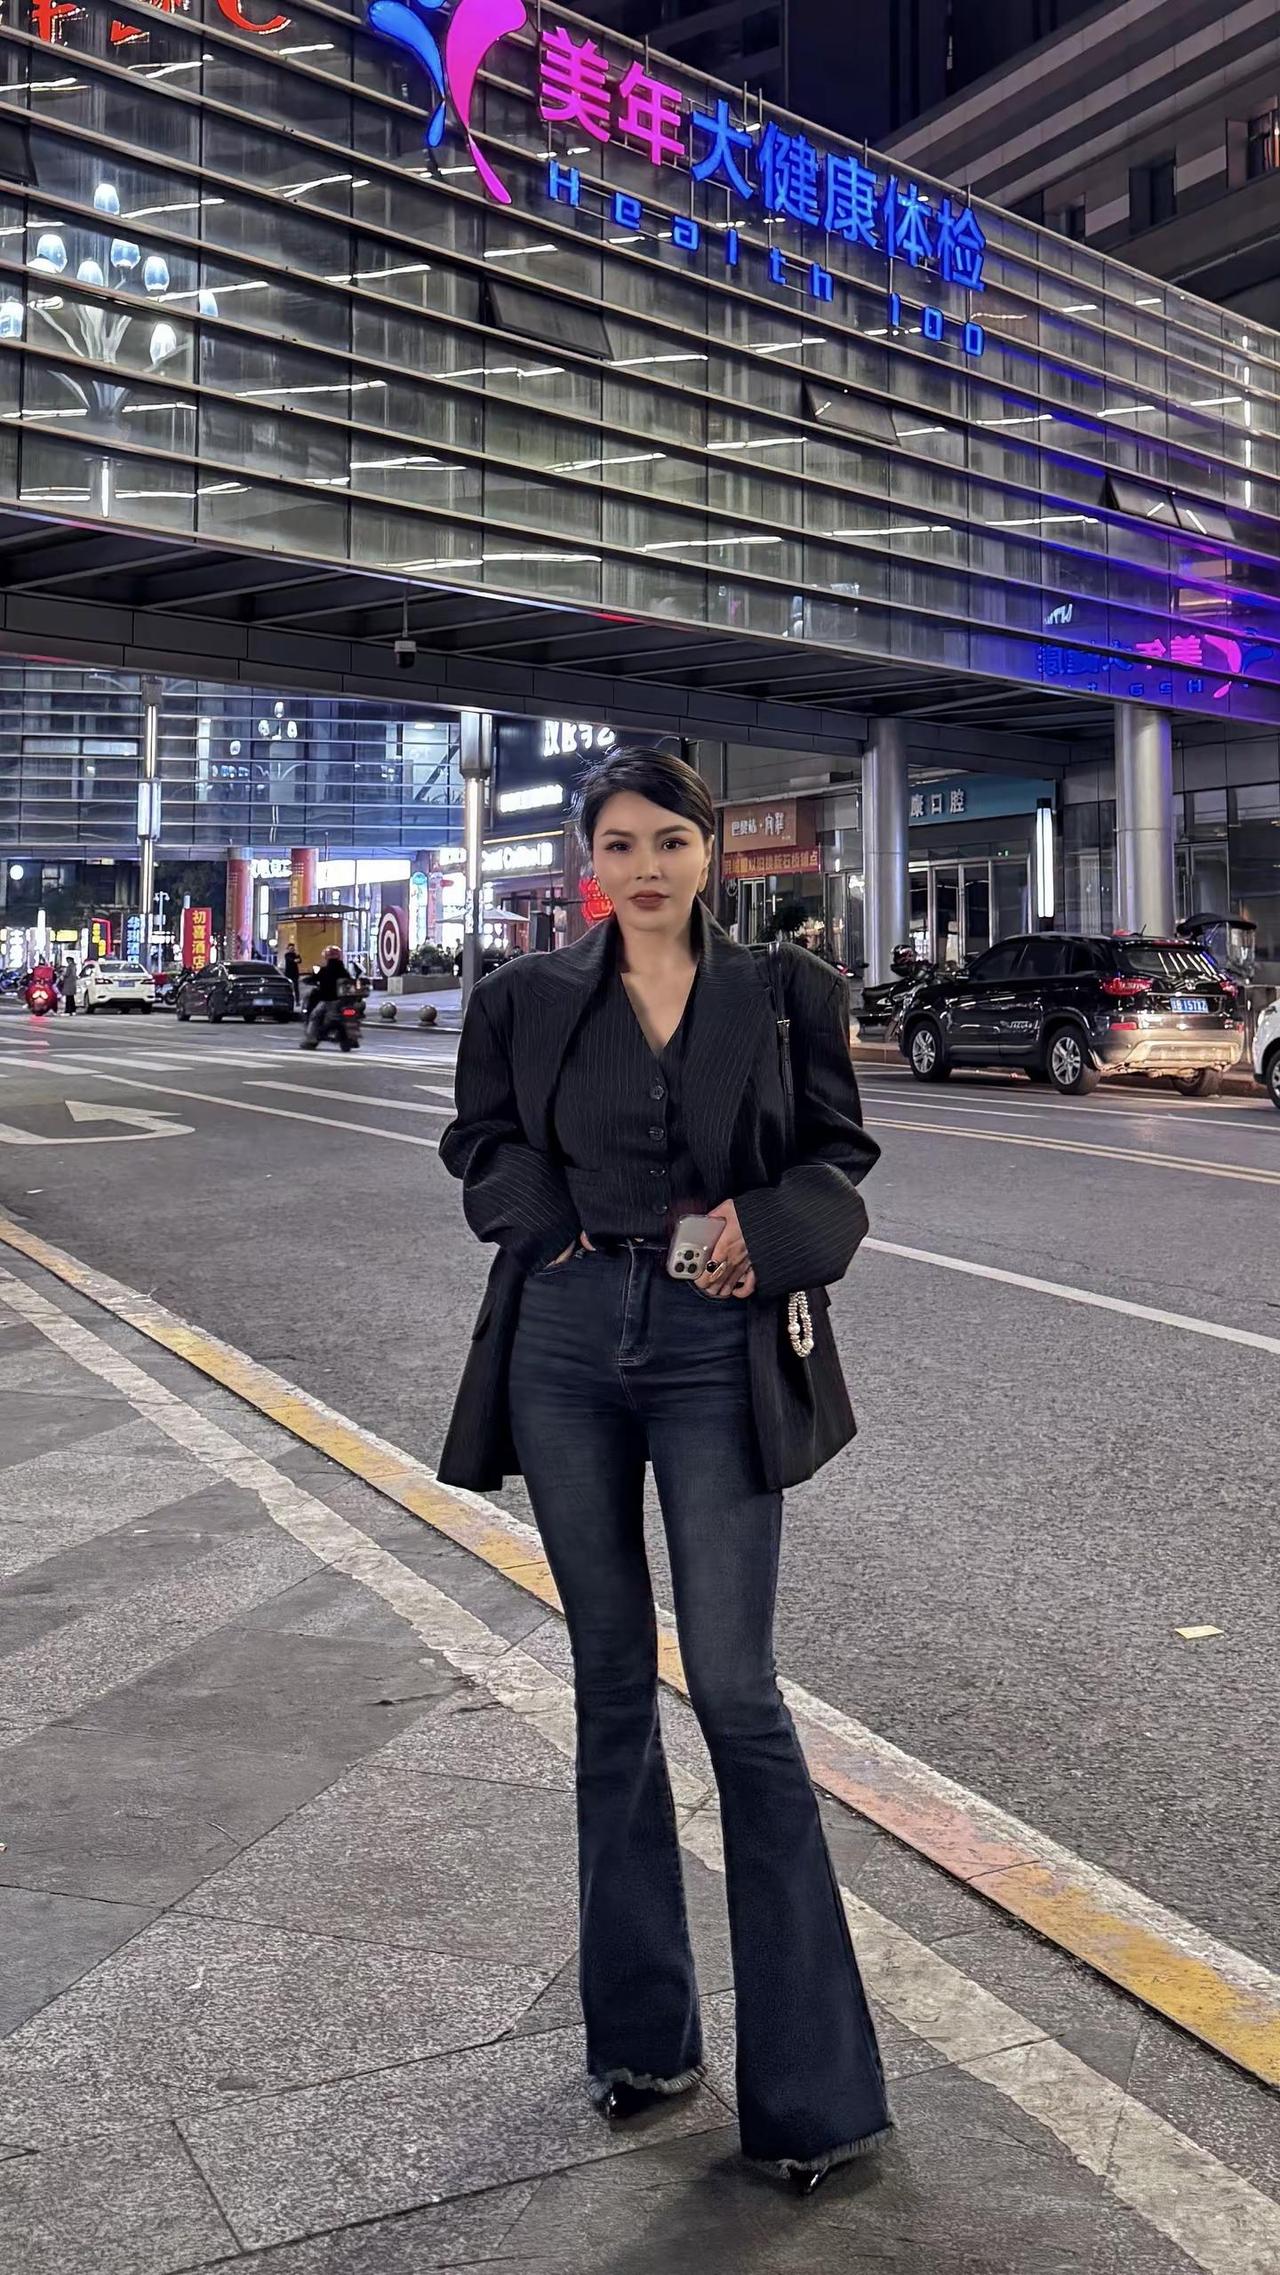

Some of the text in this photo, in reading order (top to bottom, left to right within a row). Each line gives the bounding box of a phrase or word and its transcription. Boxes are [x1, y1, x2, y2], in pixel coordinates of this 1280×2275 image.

[540, 27, 987, 292] 美年大健康体检
[549, 159, 834, 301] Health
